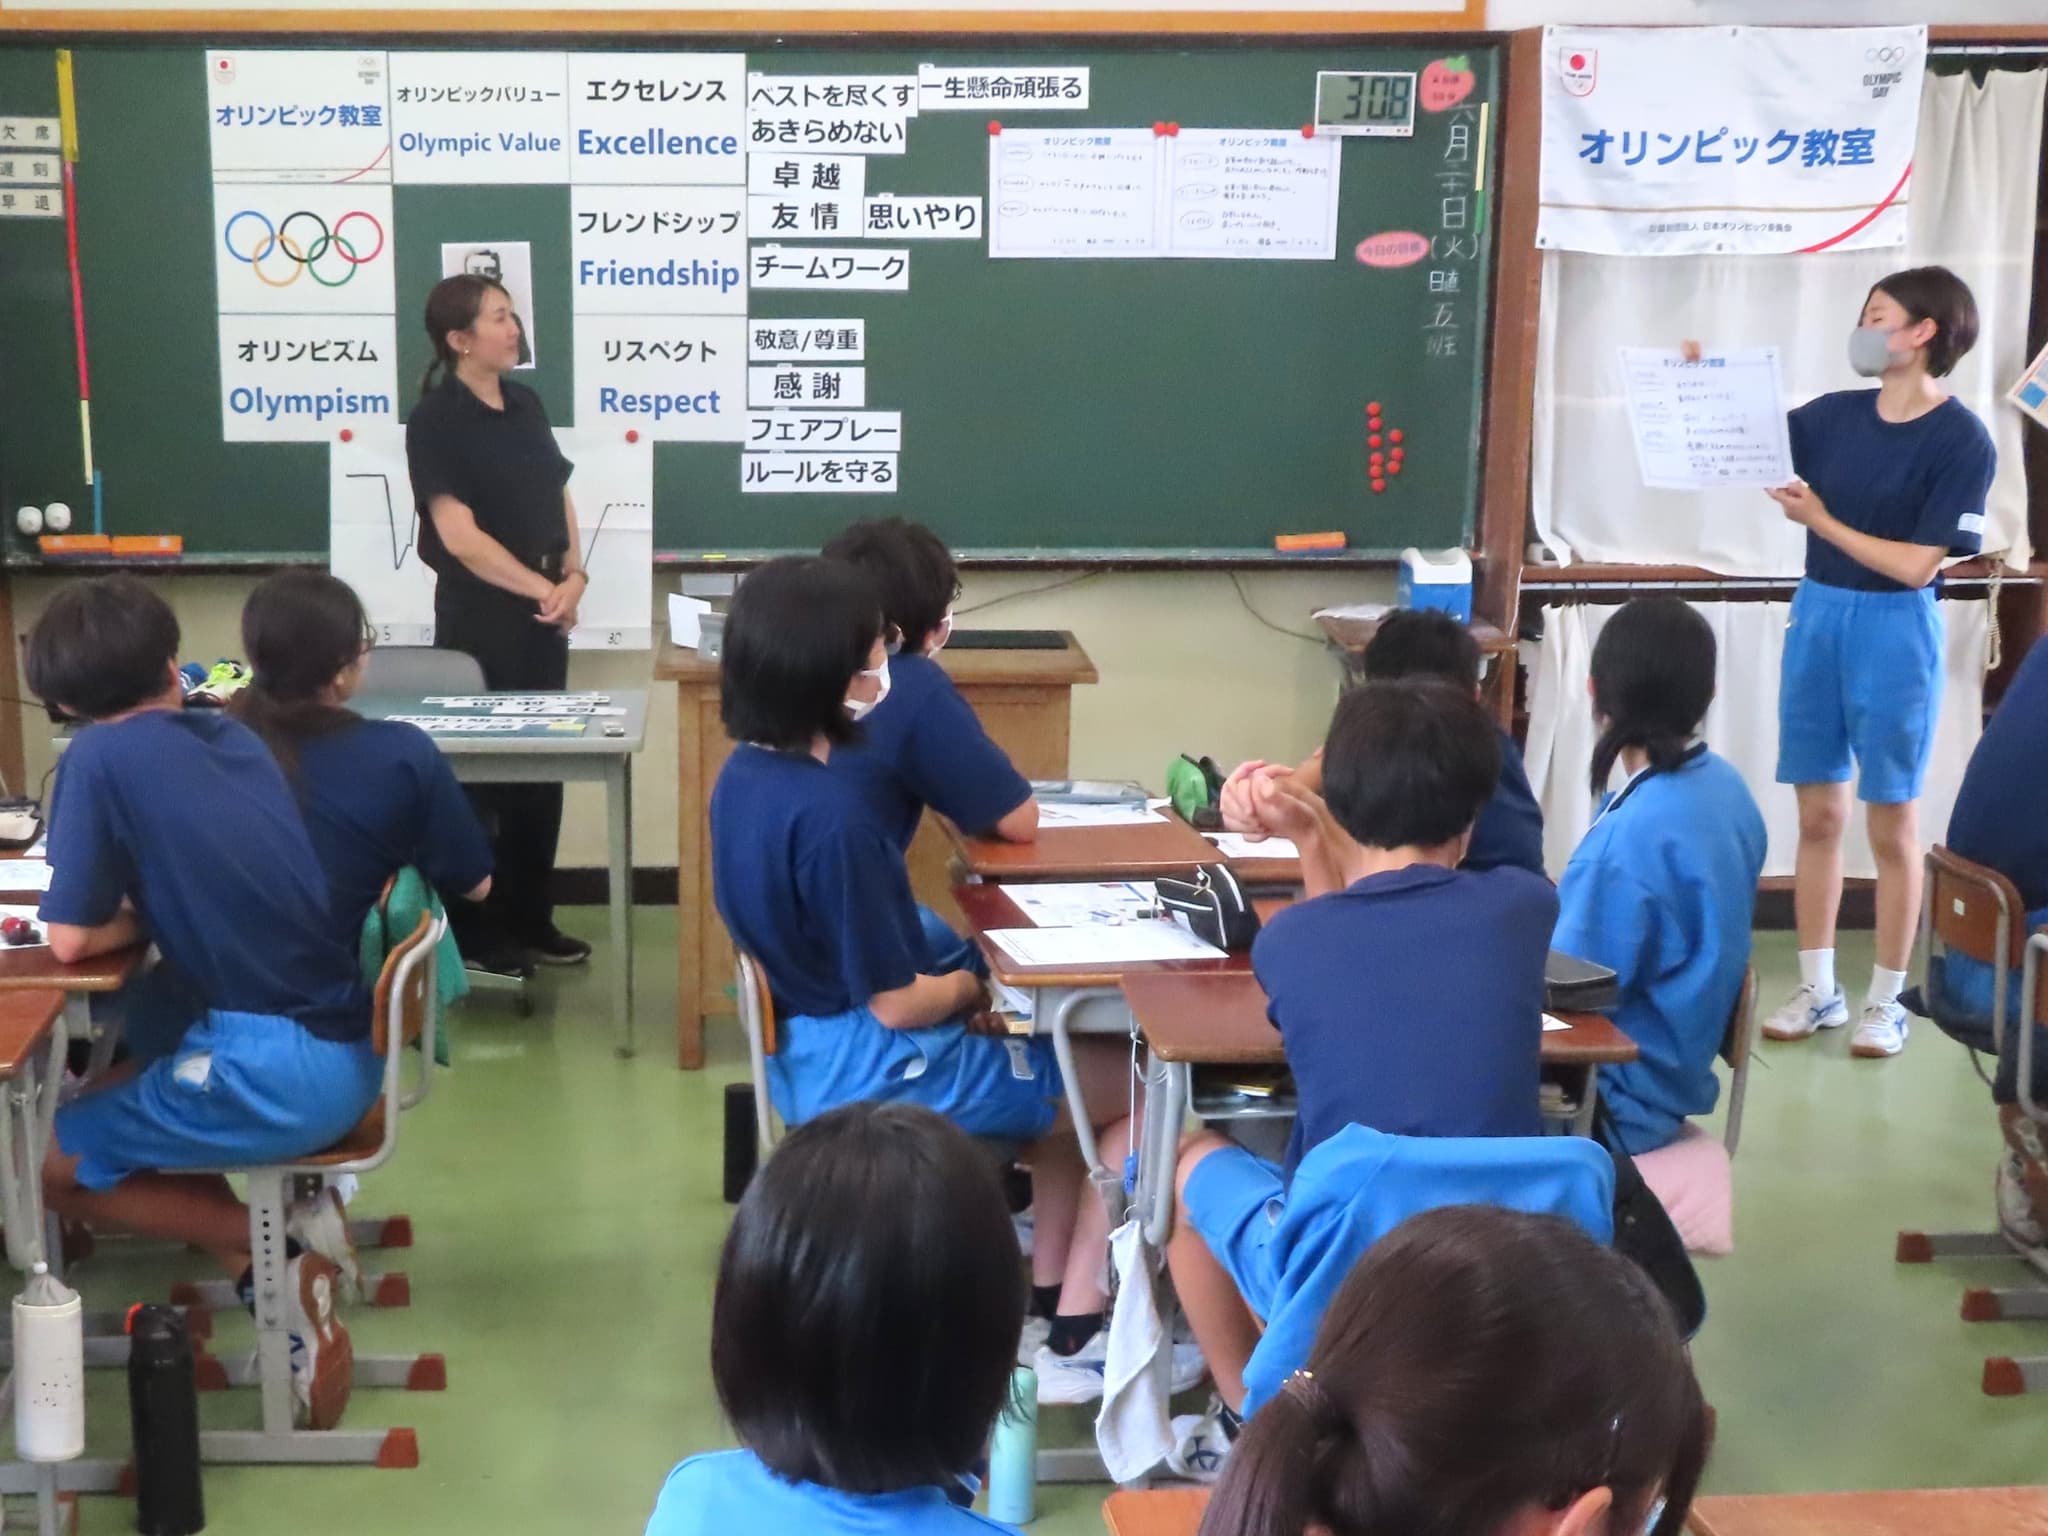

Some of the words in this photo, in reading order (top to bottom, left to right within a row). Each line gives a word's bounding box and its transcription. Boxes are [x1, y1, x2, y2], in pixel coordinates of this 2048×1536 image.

[397, 86, 561, 103] オリンピックバリュー
[587, 80, 728, 103] エクセレンス
[751, 84, 915, 107] ベストを尽くす
[920, 76, 1082, 99] 一生懸命頑張る
[216, 104, 383, 127] オリンピック教室
[578, 128, 738, 155] Excellence
[752, 119, 904, 144] あきらめない
[399, 132, 492, 157] Olympic
[499, 132, 562, 152] Value
[1578, 126, 1877, 168] オリンピック教室
[772, 161, 841, 191] 卓越
[578, 211, 741, 235] フレンドシップ
[771, 202, 839, 231] 友情
[867, 203, 976, 230] 思いやり
[580, 259, 740, 293] Friendship
[756, 255, 905, 280] チームワーク
[238, 339, 378, 363] オリンピズム
[604, 340, 717, 363] リスペクト
[754, 328, 859, 352] 敬意/尊重
[773, 372, 841, 400] 感謝
[230, 387, 389, 421] Olympism
[600, 387, 720, 420] Respect
[751, 417, 897, 442] フェアプレー
[745, 461, 893, 484] ルールを守る
